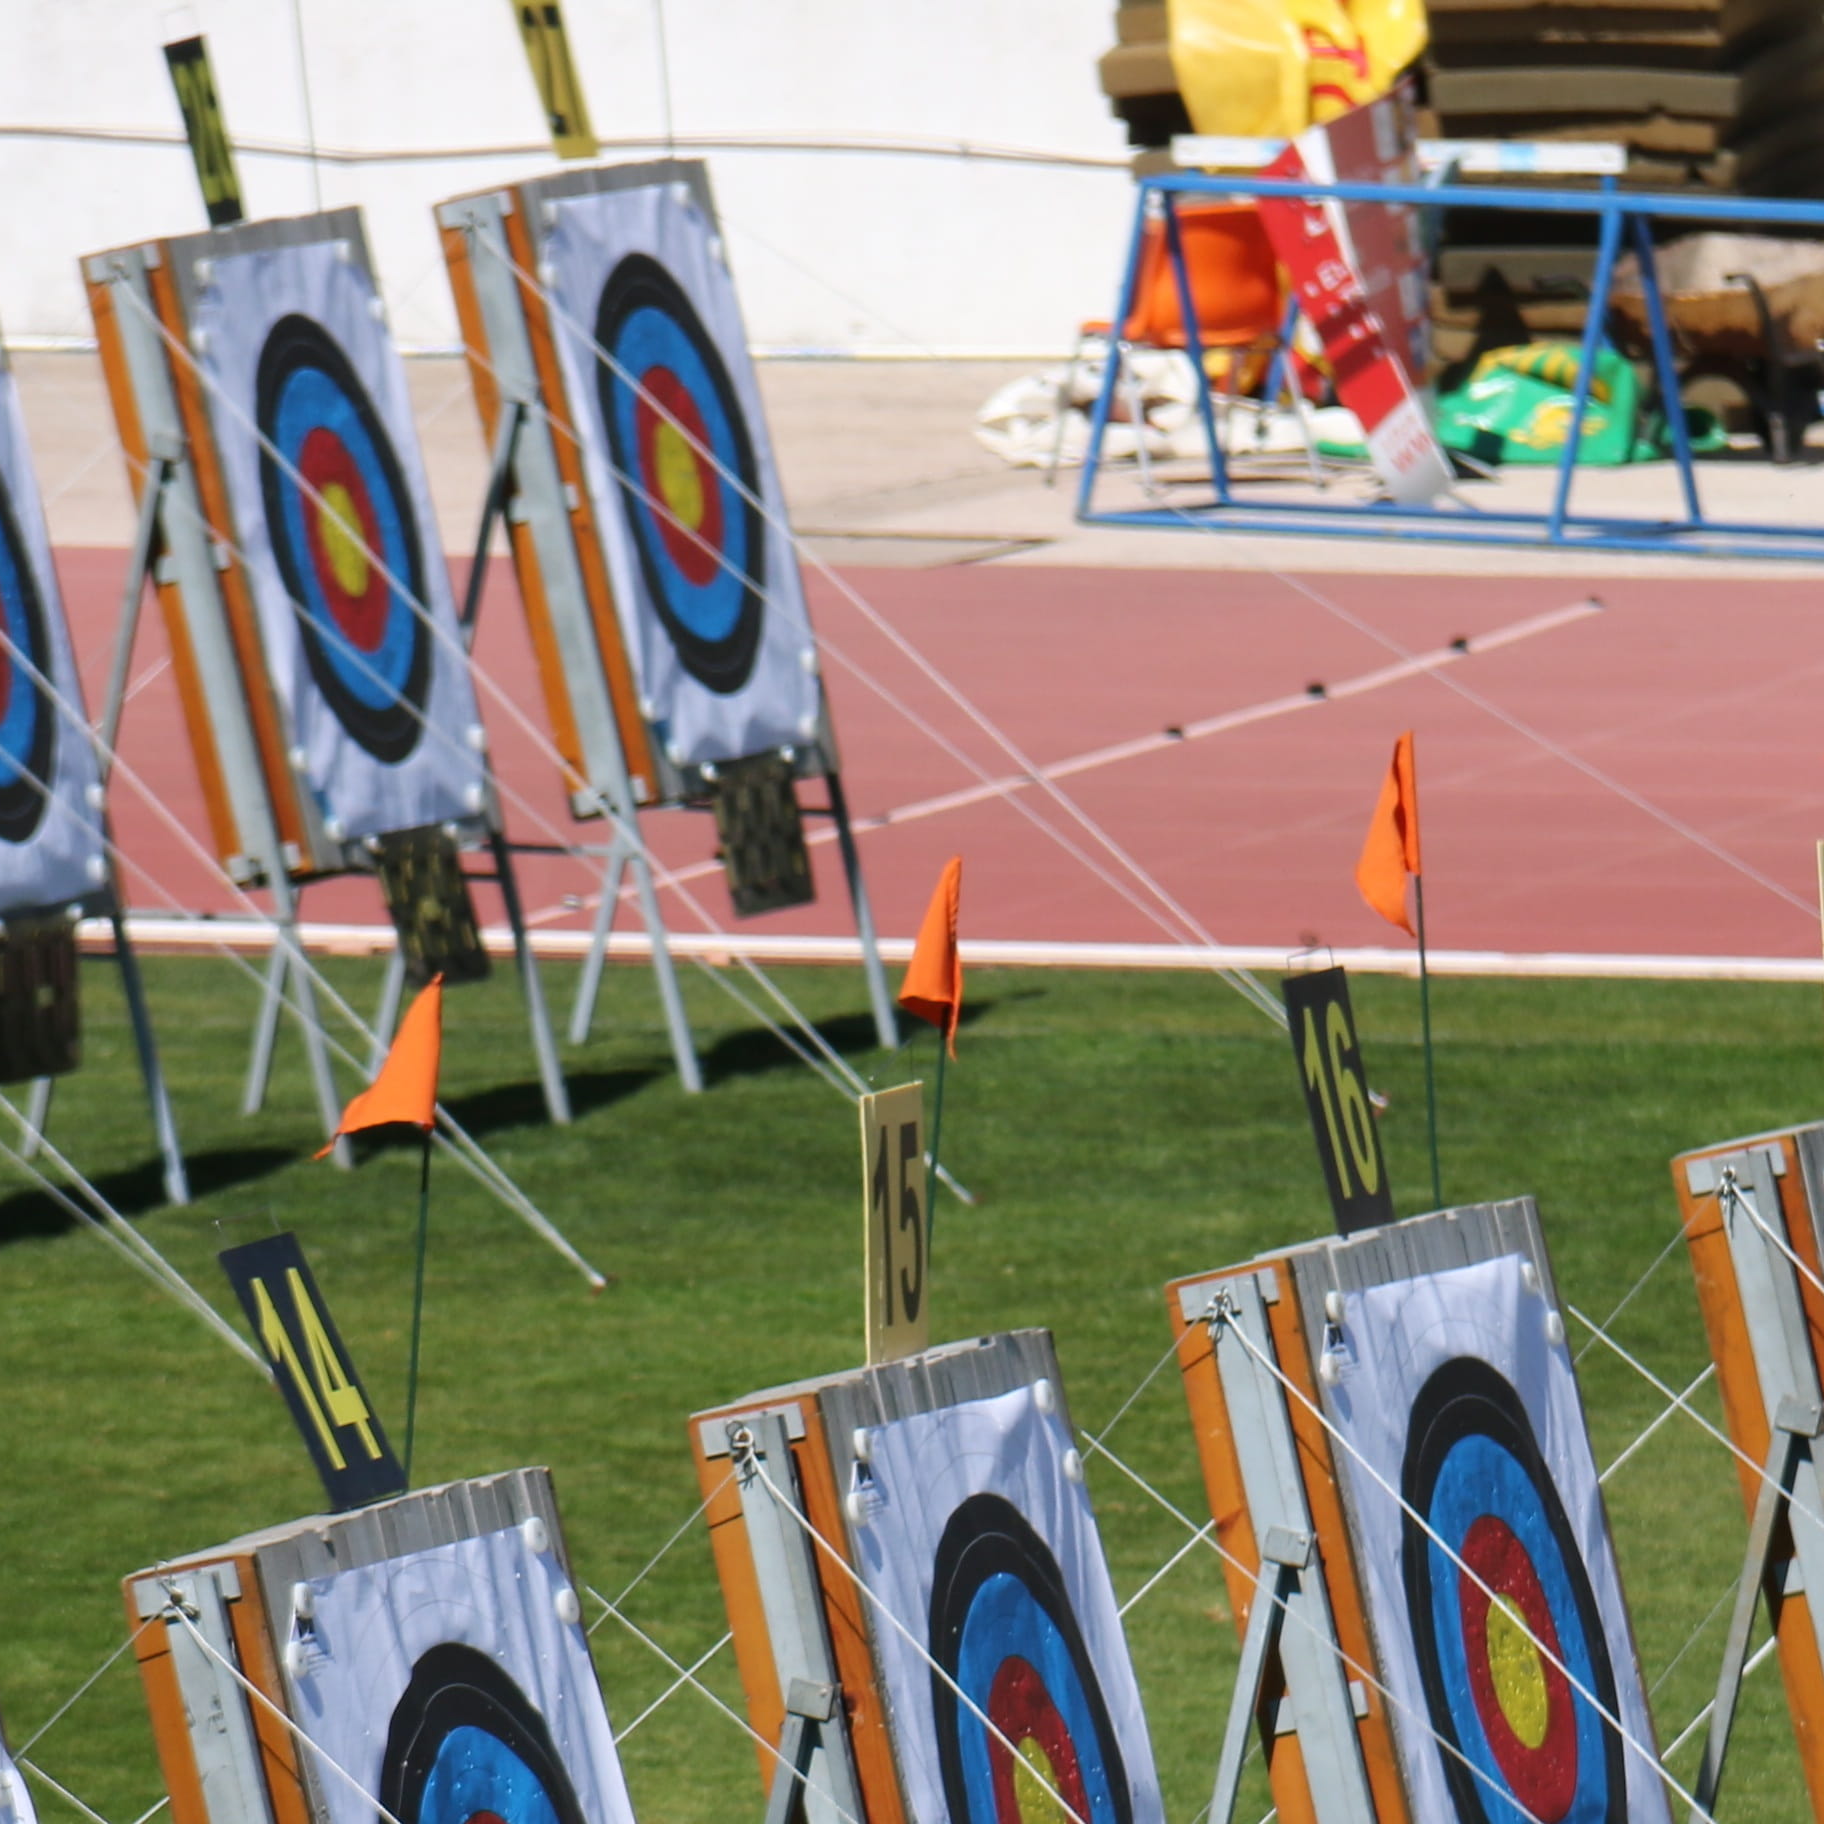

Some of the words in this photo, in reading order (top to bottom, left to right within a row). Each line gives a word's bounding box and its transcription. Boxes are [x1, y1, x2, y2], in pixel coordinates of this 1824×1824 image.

[174, 57, 239, 204] 26
[522, 5, 589, 137] 27
[1301, 998, 1378, 1199] 16
[871, 1121, 923, 1325] 15
[248, 1266, 384, 1470] 14
